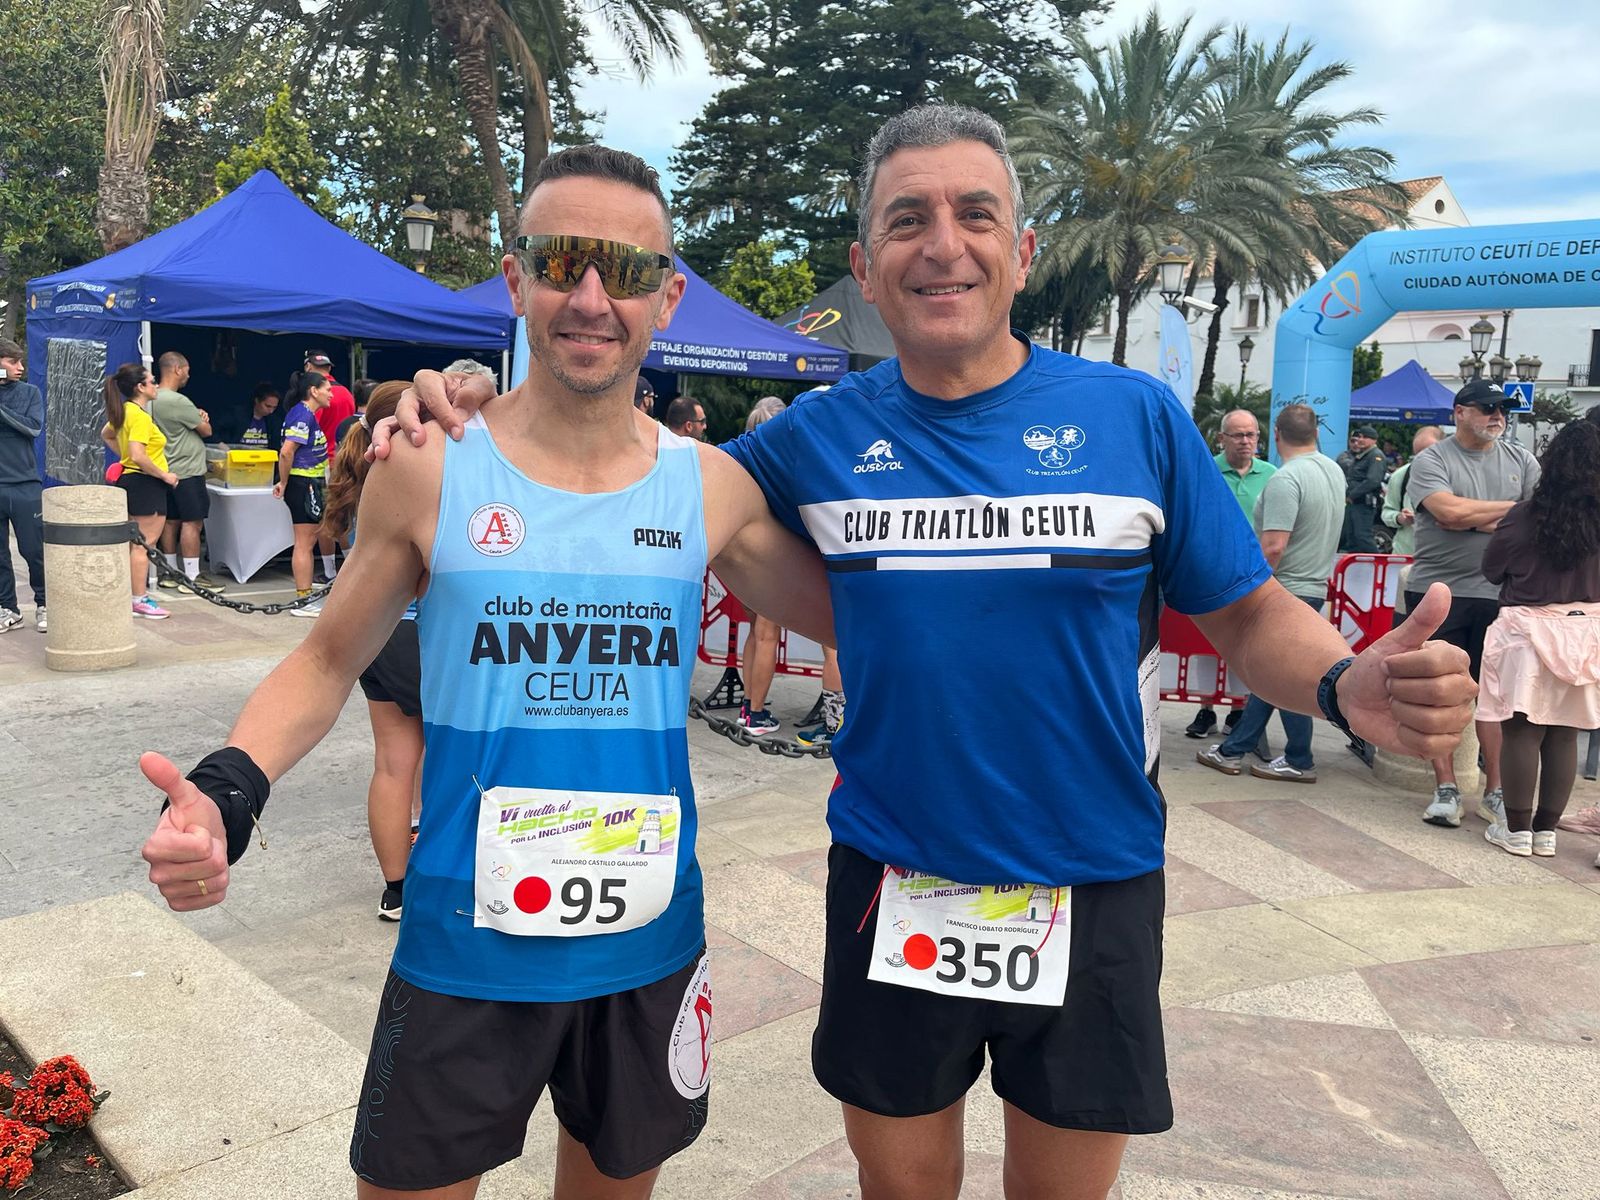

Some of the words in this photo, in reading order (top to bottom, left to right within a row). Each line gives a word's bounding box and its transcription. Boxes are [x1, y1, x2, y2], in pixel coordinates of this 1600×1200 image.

[1389, 246, 1475, 265] INSTITUTO
[1480, 240, 1533, 260] CEUTÍ
[1536, 241, 1561, 257] DE
[1404, 275, 1462, 289] CIUDAD
[1466, 271, 1559, 287] AUTÓNOMA
[1563, 270, 1586, 283] DE
[663, 355, 700, 368] EVENTOS
[701, 358, 748, 372] DEPORTIVOS
[684, 344, 740, 359] ORGANIZACIÓN
[740, 350, 747, 359] Y
[747, 350, 777, 362] GESTIÓN
[778, 353, 788, 362] DE
[1025, 468, 1039, 476] CLUB
[1071, 464, 1088, 475] CEUTA
[844, 511, 891, 543] CLUB
[902, 502, 1009, 540] TRIATLÓN
[1022, 504, 1096, 538] CEUTA
[484, 595, 533, 616] club
[540, 596, 569, 617] de
[575, 601, 672, 621] montaña
[469, 622, 680, 667] ANYERA
[524, 671, 630, 702] CEUTA
[524, 704, 629, 720] www.clubanyera.es
[523, 802, 557, 819] vuelta
[558, 799, 572, 813] al
[602, 807, 638, 828] 10K
[510, 837, 526, 845] POR
[538, 820, 592, 839] INCLUSIÓN
[551, 858, 588, 866] ALEJANDRO
[588, 859, 616, 867] CASTILLO
[559, 876, 627, 926] 95
[933, 886, 982, 898] INCLUSIÓN
[946, 919, 978, 931] FRANCISCO
[1004, 926, 1039, 935] RODRÍGUEZ
[936, 936, 1040, 992] 350
[673, 1015, 685, 1046] Club
[683, 996, 691, 1012] de
